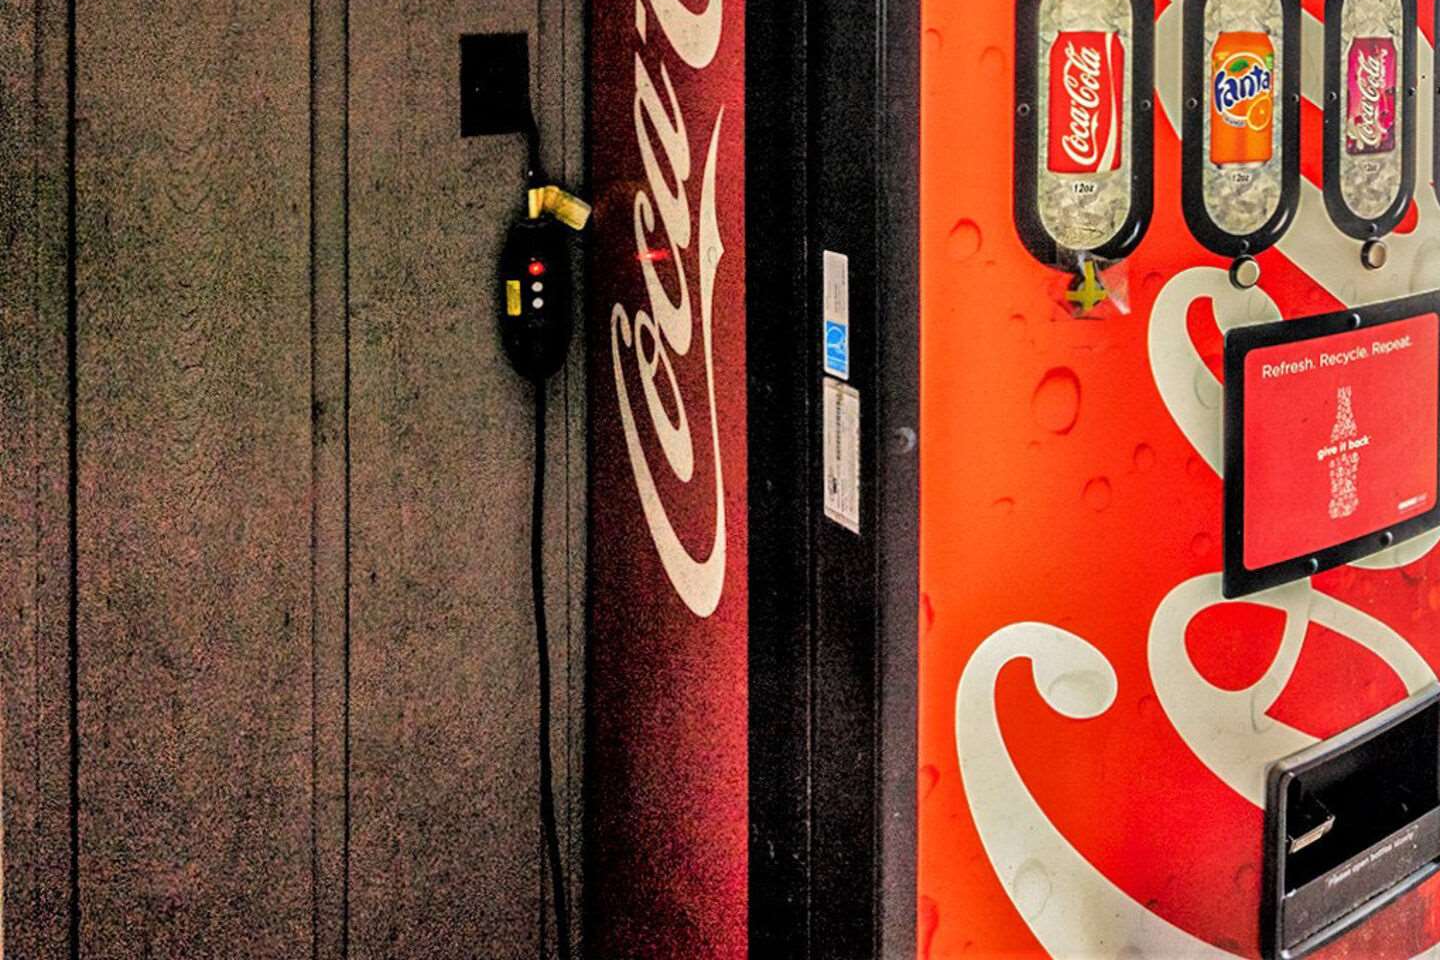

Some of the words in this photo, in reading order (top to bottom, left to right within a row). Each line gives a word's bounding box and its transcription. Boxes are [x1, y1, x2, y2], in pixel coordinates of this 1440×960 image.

[1062, 40, 1101, 166] Coca-Cola
[1073, 183, 1094, 194] 12oz
[1232, 172, 1250, 183] 12oz
[1262, 357, 1315, 379] Refresh.
[1320, 345, 1369, 367] Recycle.
[1372, 335, 1412, 356] Repeat.
[1317, 444, 1337, 461] give
[1339, 441, 1347, 453] it
[1348, 435, 1369, 450] back
